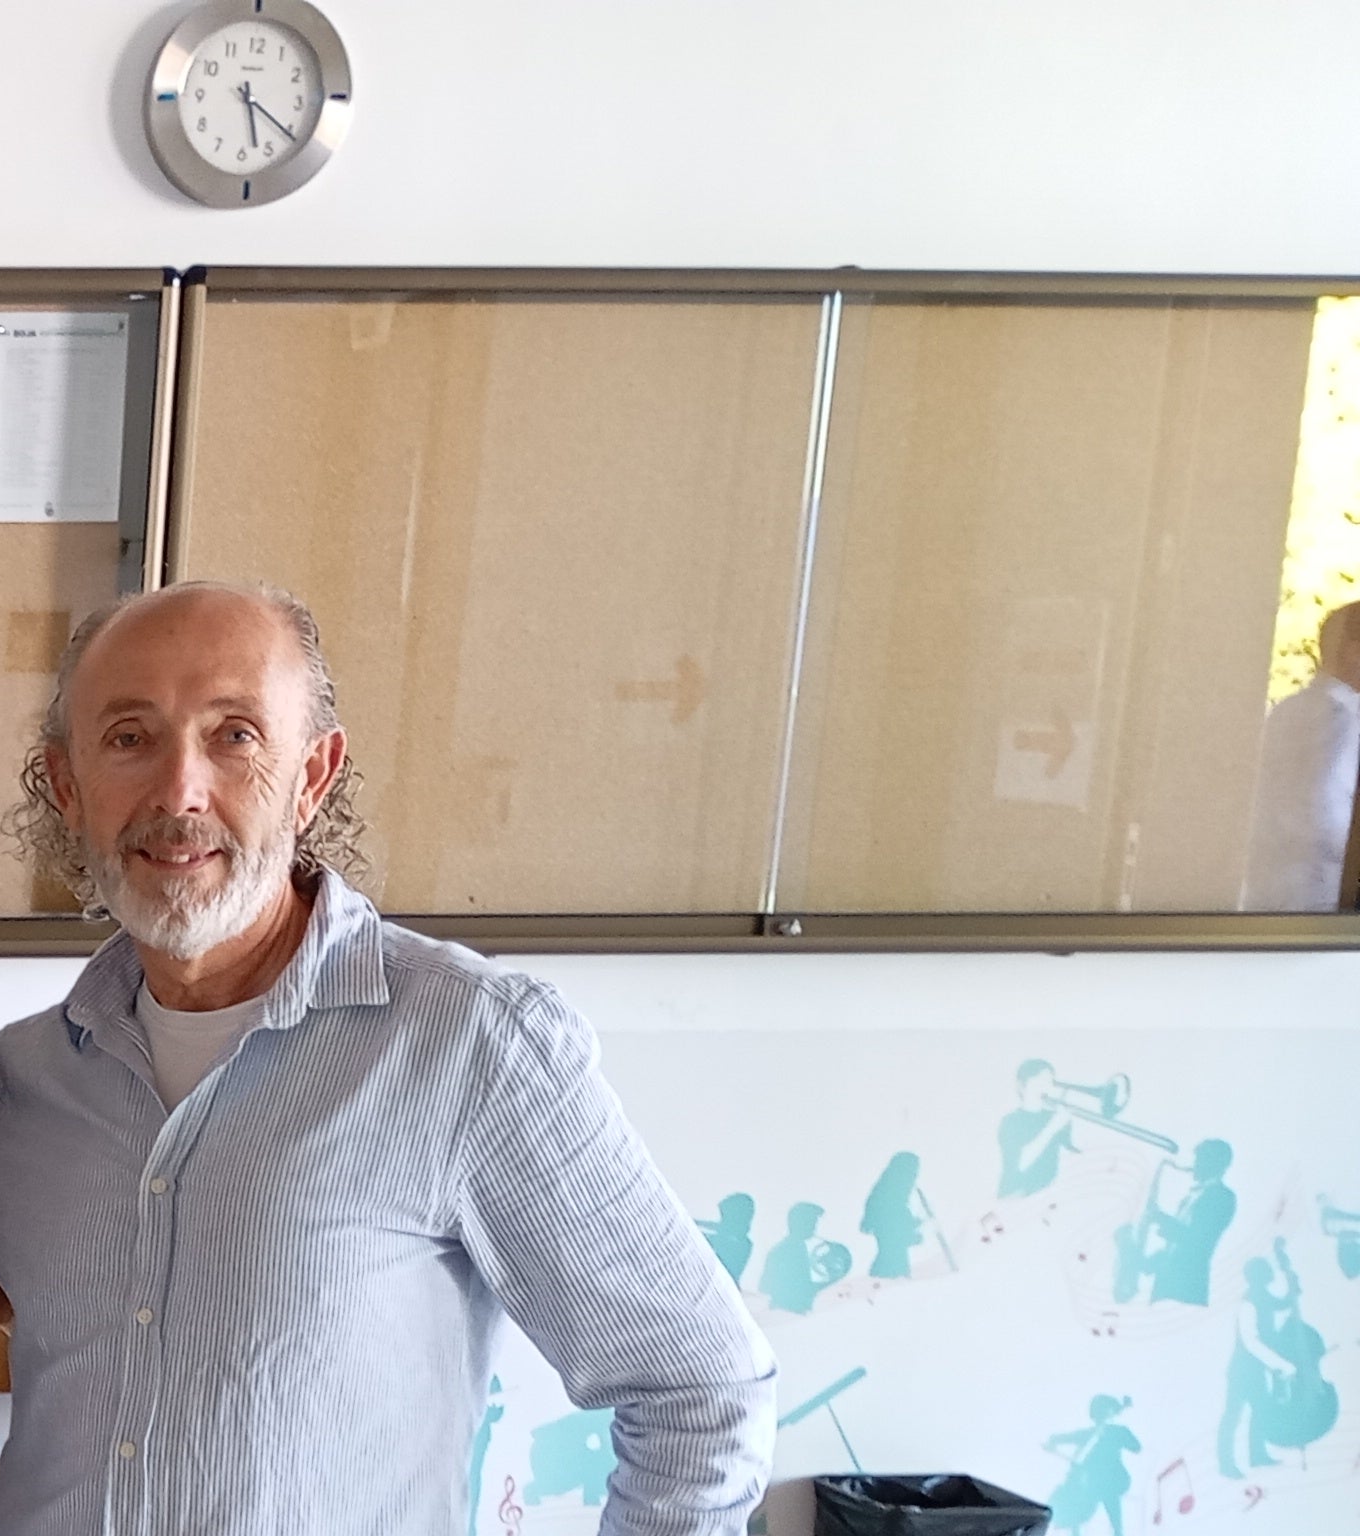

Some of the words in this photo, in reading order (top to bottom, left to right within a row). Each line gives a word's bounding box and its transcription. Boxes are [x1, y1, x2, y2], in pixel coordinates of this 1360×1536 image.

[224, 41, 237, 58] 11
[249, 37, 266, 54] 12
[279, 46, 285, 61] 1
[204, 59, 219, 77] 10
[291, 68, 301, 83] 2
[194, 88, 205, 102] 9
[293, 94, 303, 111] 3
[196, 117, 207, 132] 8
[214, 137, 223, 152] 7
[263, 141, 274, 157] 5
[236, 149, 247, 161] 6
